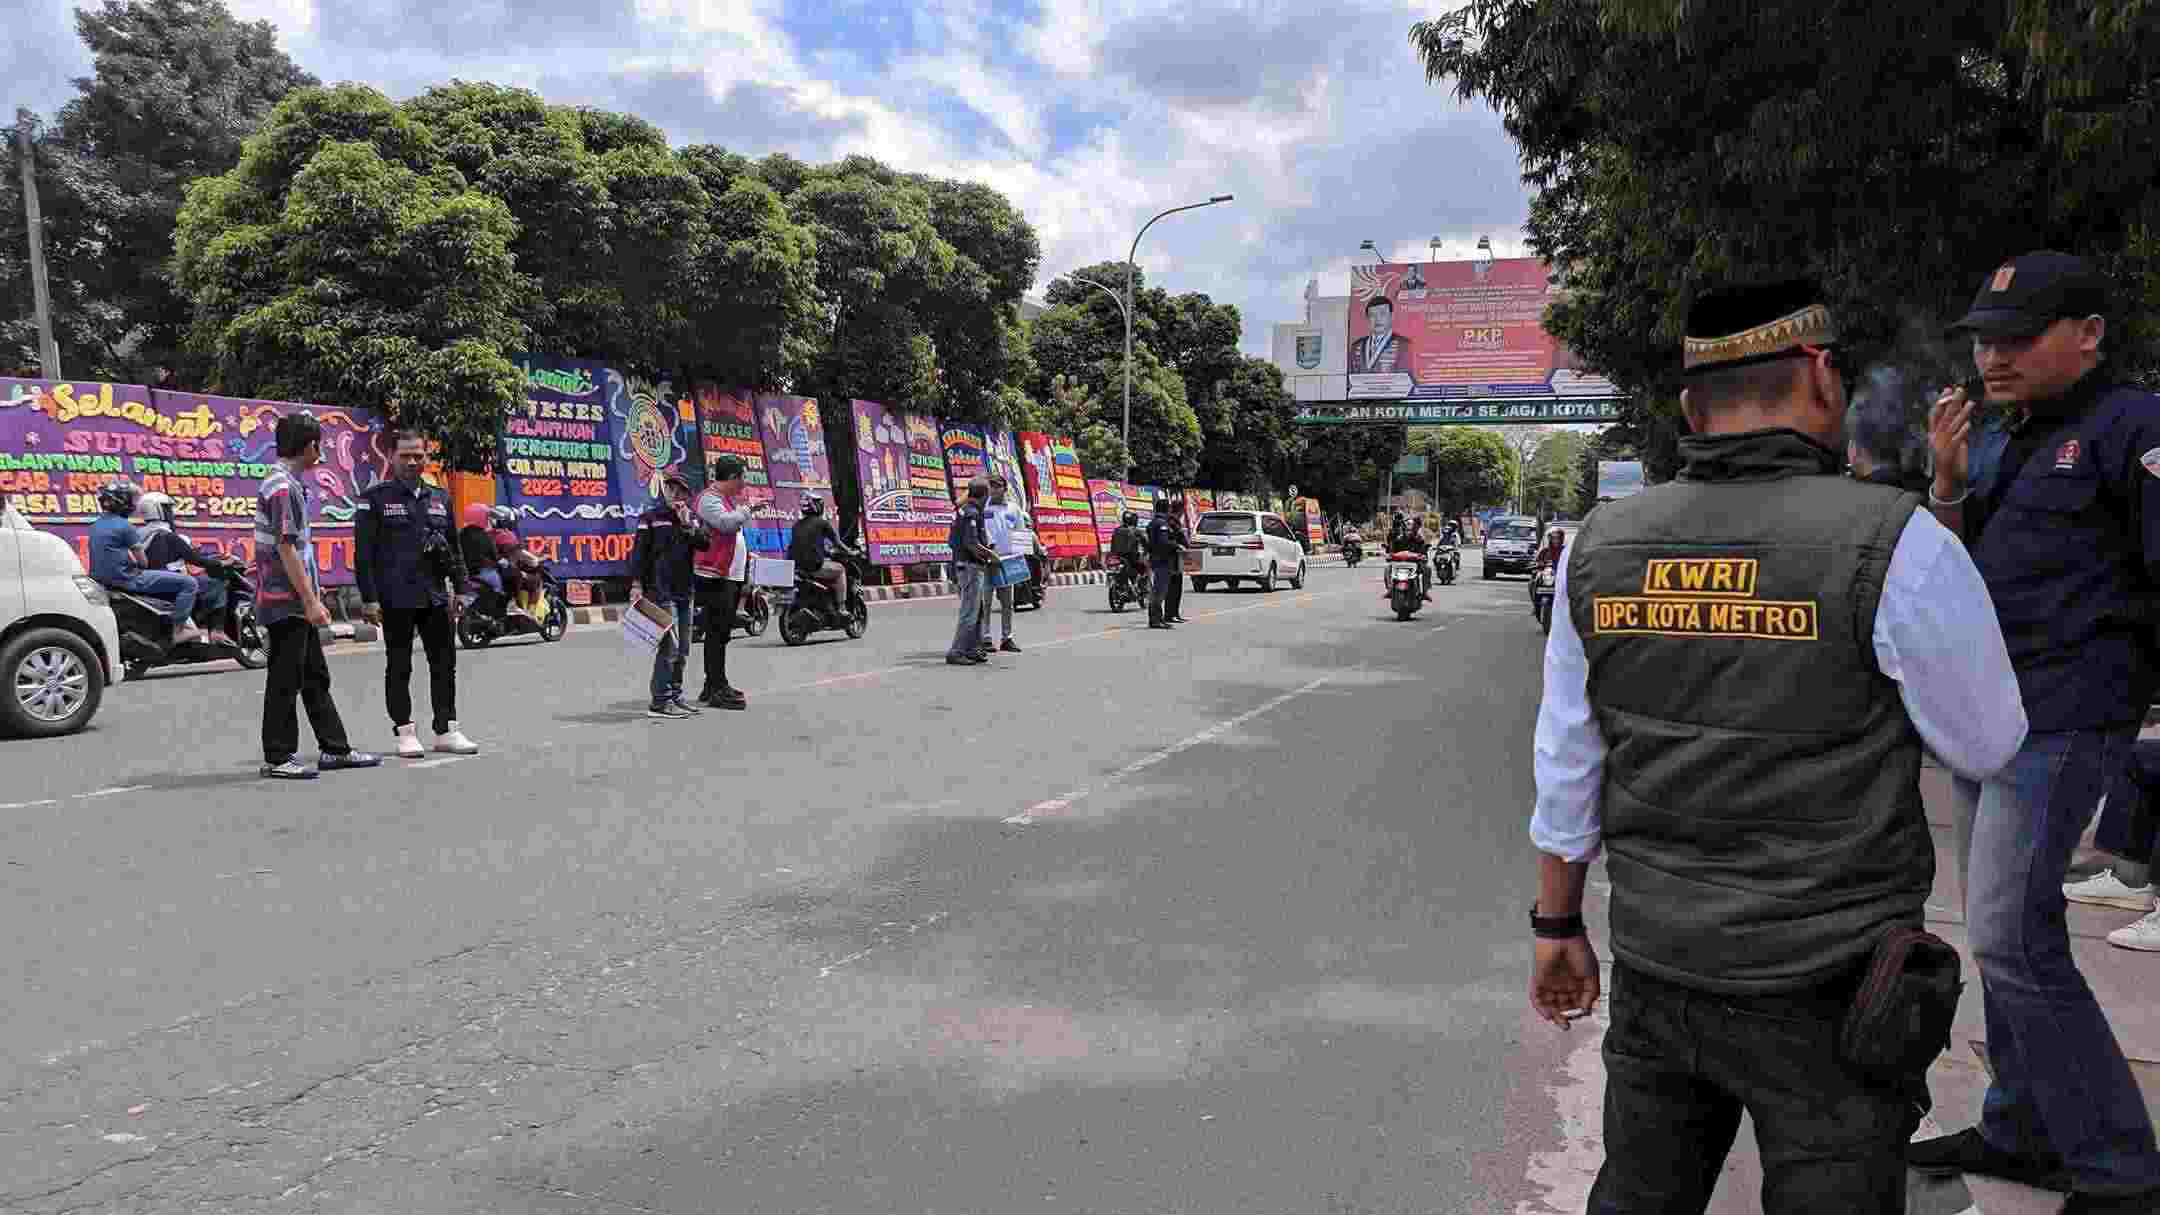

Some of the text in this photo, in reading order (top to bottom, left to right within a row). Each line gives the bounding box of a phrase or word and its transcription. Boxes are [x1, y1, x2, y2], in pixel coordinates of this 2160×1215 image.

[1463, 328, 1503, 343] PKP
[53, 384, 223, 439] Selamat
[1375, 406, 1414, 418] KOTA
[1553, 402, 1596, 417] KOTA
[64, 431, 224, 460] SUKSES
[504, 437, 589, 459] PENGURUS
[133, 458, 235, 476] PENGURUS
[143, 475, 224, 496] METRO
[1599, 603, 1808, 634] DPC KOTA METRO
